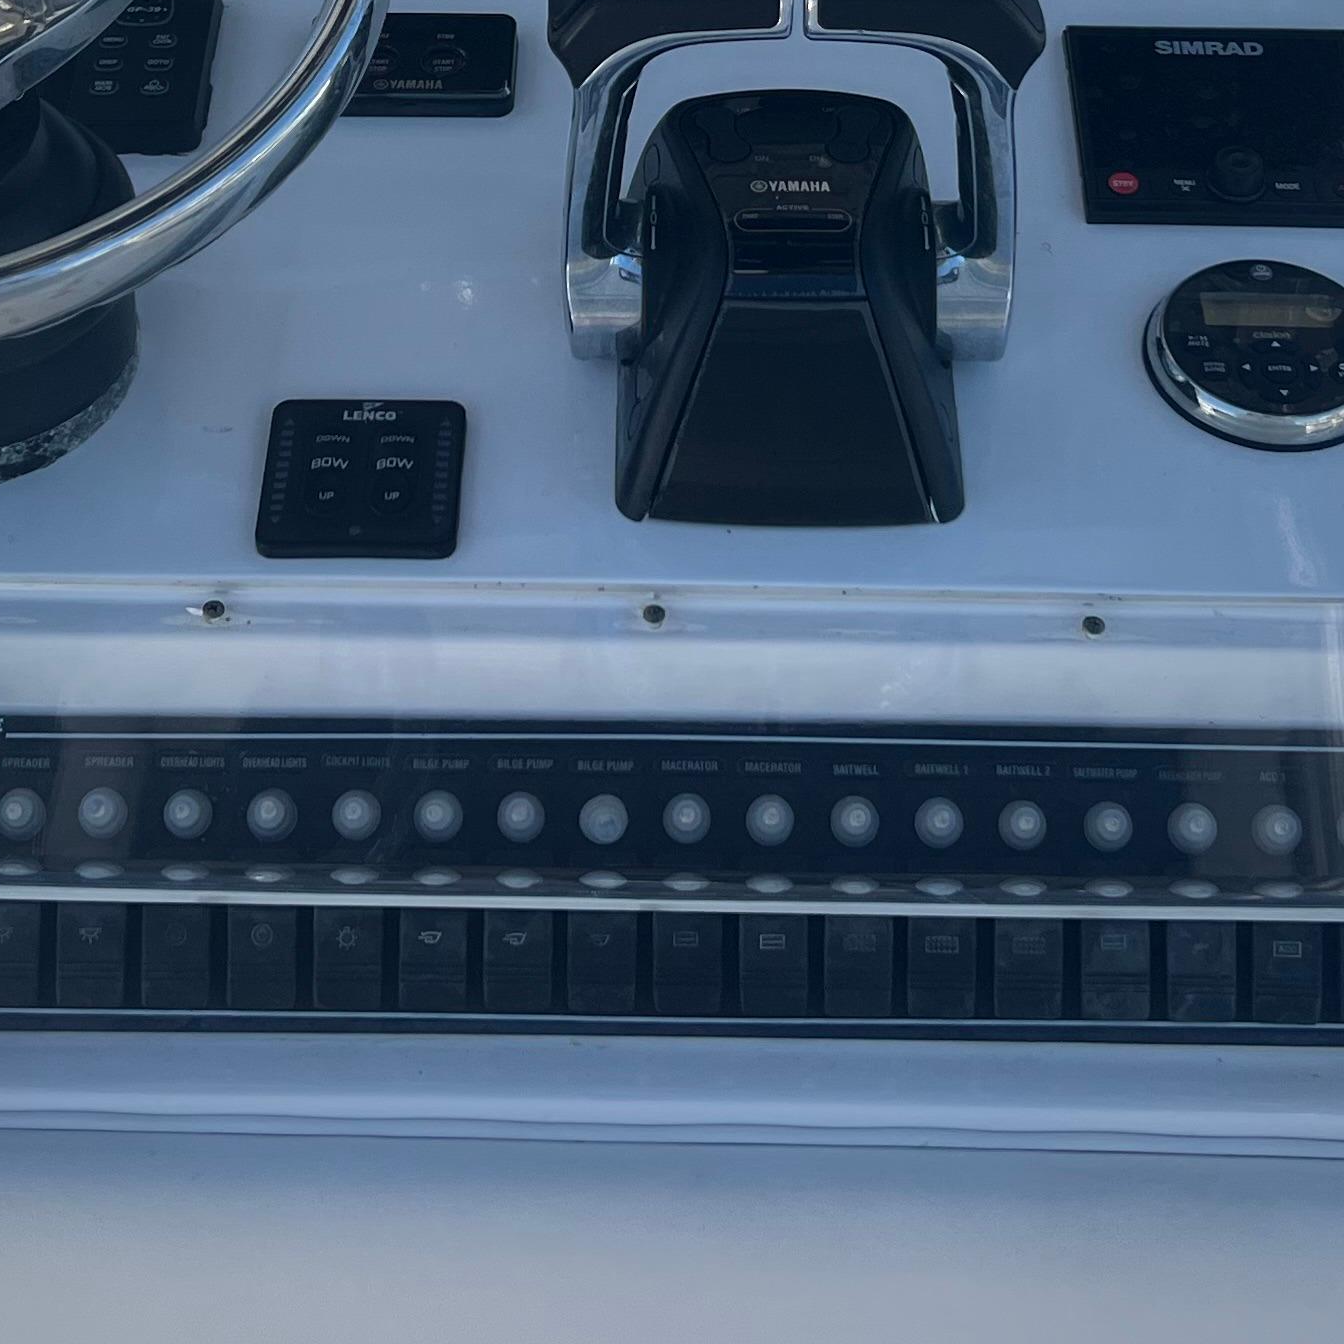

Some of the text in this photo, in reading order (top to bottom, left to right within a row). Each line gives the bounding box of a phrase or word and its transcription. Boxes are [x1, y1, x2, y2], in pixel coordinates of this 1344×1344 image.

[1154, 40, 1265, 57] SIMRAD
[390, 79, 444, 90] YAMAHA
[769, 179, 832, 193] YAMAHA
[1274, 182, 1302, 192] MODE
[1267, 364, 1293, 373] ENTER
[342, 409, 397, 422] LENCO
[316, 434, 351, 444] DOWN
[380, 435, 416, 444] DOWN
[311, 456, 349, 470] BOW
[376, 456, 414, 471] BOW
[318, 490, 335, 501] UP
[384, 490, 400, 501] UP
[2, 757, 51, 769] SPREADER
[84, 756, 135, 768] SPREADER
[412, 759, 470, 770] BILGE PUMP
[496, 759, 554, 770] BILGE PUMP
[577, 760, 635, 772] BILGE PUMP
[661, 760, 719, 772] MACERATOR
[744, 761, 802, 774] MACERATOR
[832, 763, 879, 777] BAITWELL
[914, 763, 960, 776] BAITWELL
[996, 764, 1043, 776] BAITWELL
